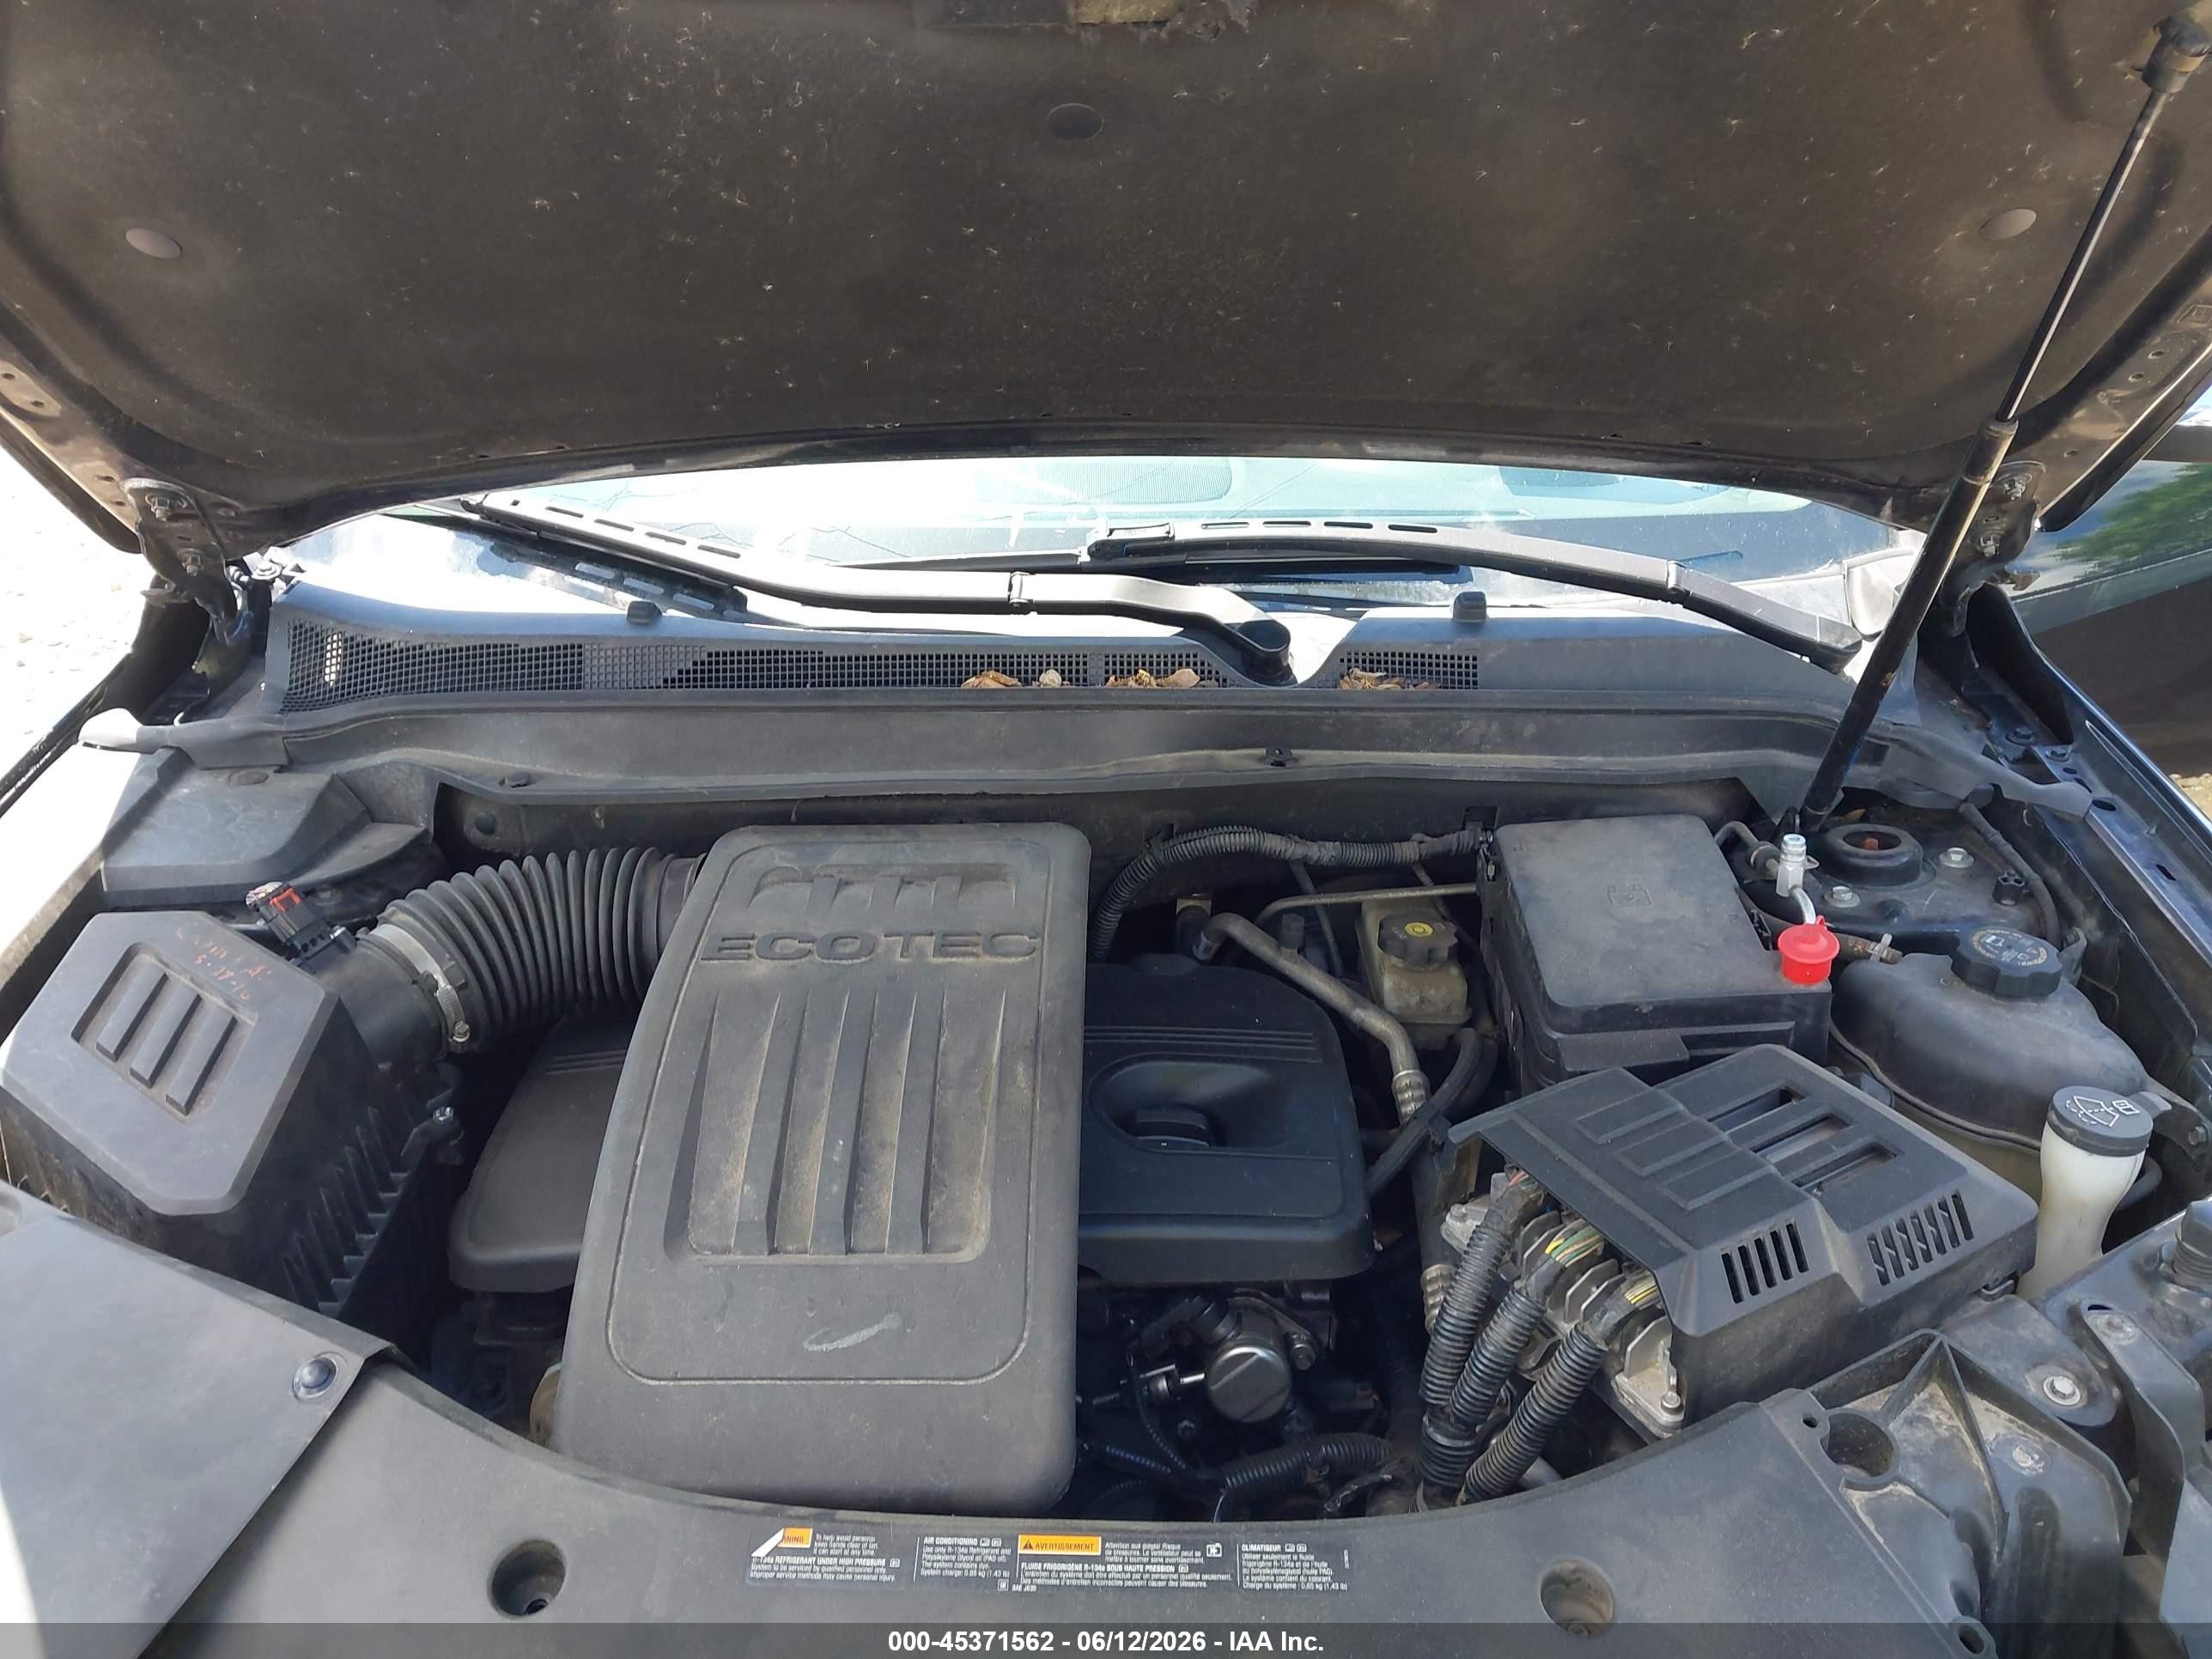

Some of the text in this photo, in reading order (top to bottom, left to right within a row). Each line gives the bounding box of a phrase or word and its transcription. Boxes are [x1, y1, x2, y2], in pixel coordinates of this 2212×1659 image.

[700, 931, 1042, 963] ECOTEC
[935, 1537, 978, 1546] CONDITIONING
[1036, 1542, 1094, 1551] AVERTISSEMENT
[775, 1556, 816, 1565] REFRIGERANT
[817, 1557, 837, 1565] UNDER
